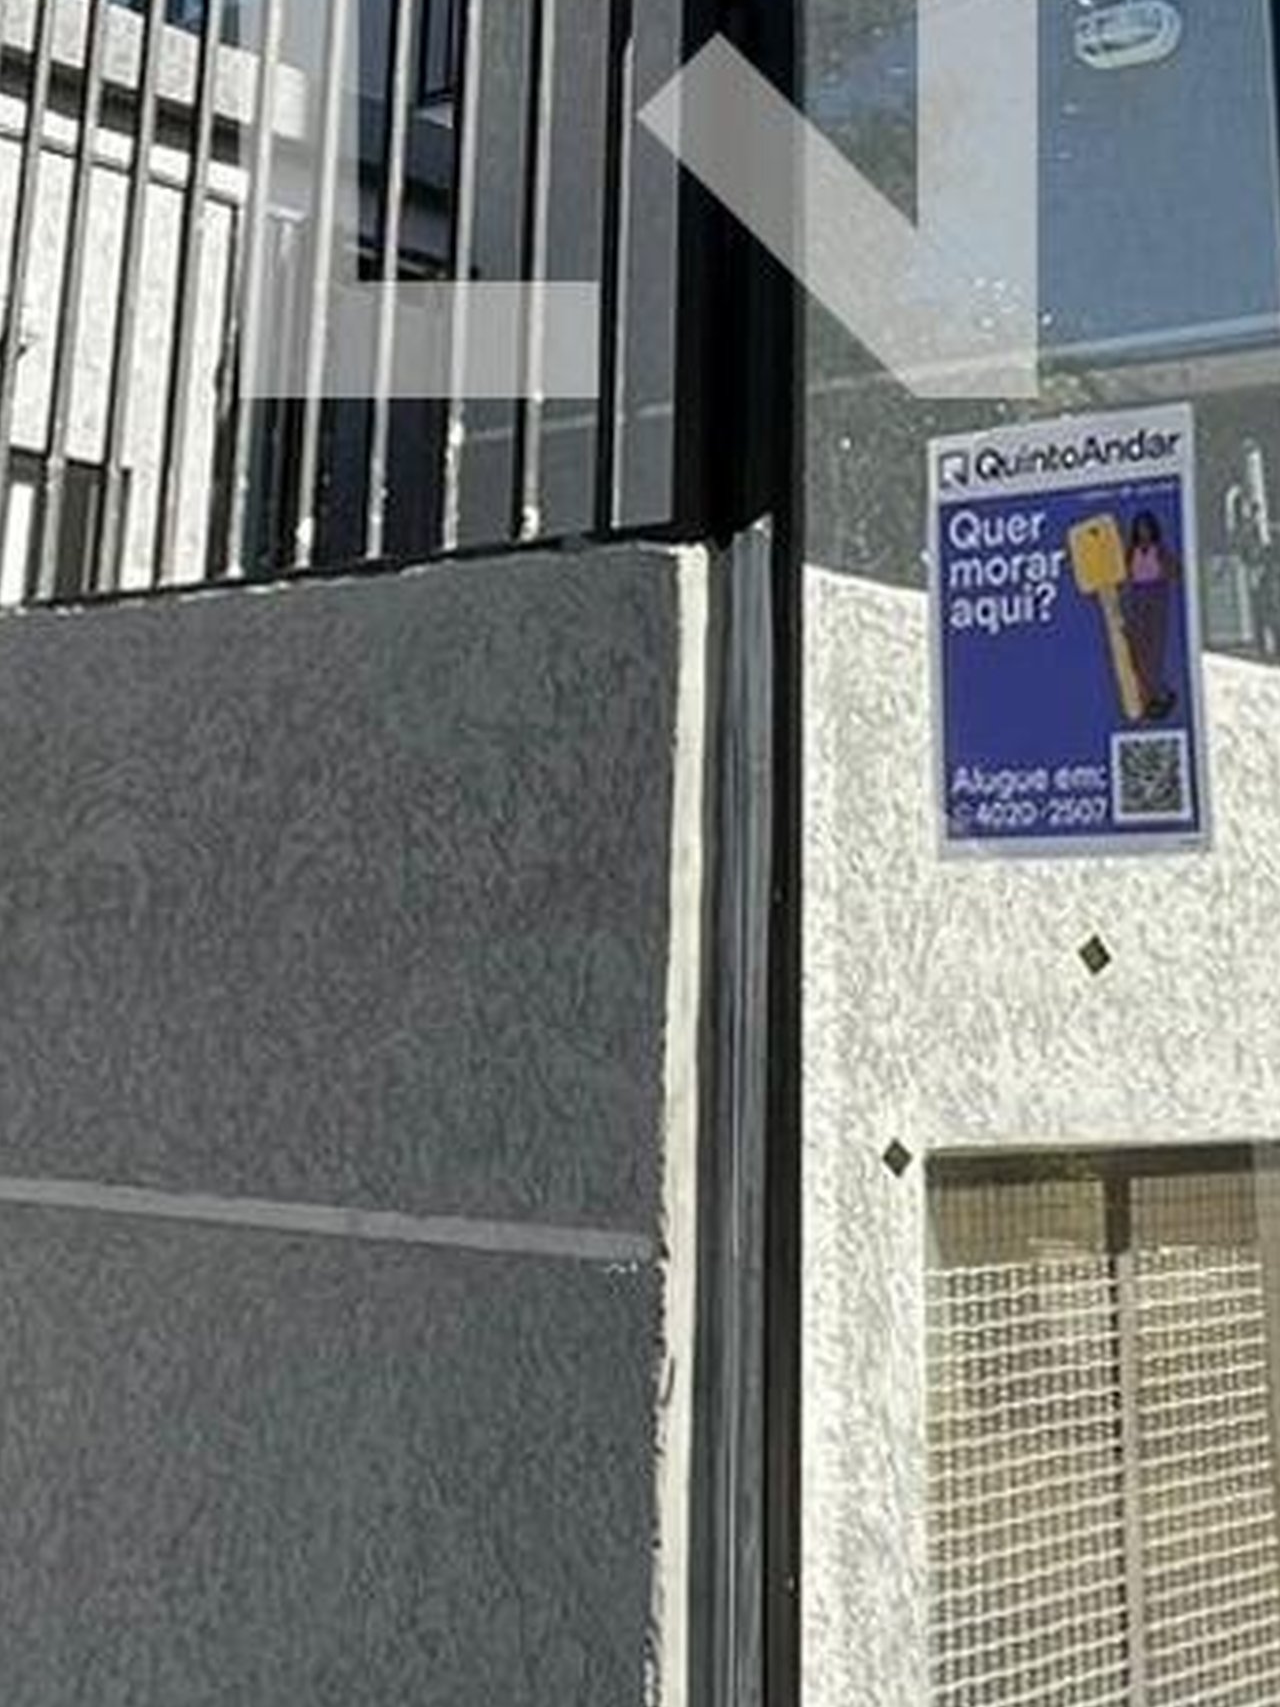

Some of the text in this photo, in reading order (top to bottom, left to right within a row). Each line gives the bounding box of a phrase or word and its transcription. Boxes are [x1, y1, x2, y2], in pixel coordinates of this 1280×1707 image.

[975, 429, 1181, 481] QuintoAndar
[949, 510, 1046, 549] Quer
[949, 551, 1066, 587] morar
[949, 582, 1057, 634] aqui?
[951, 766, 1048, 800] Alugue
